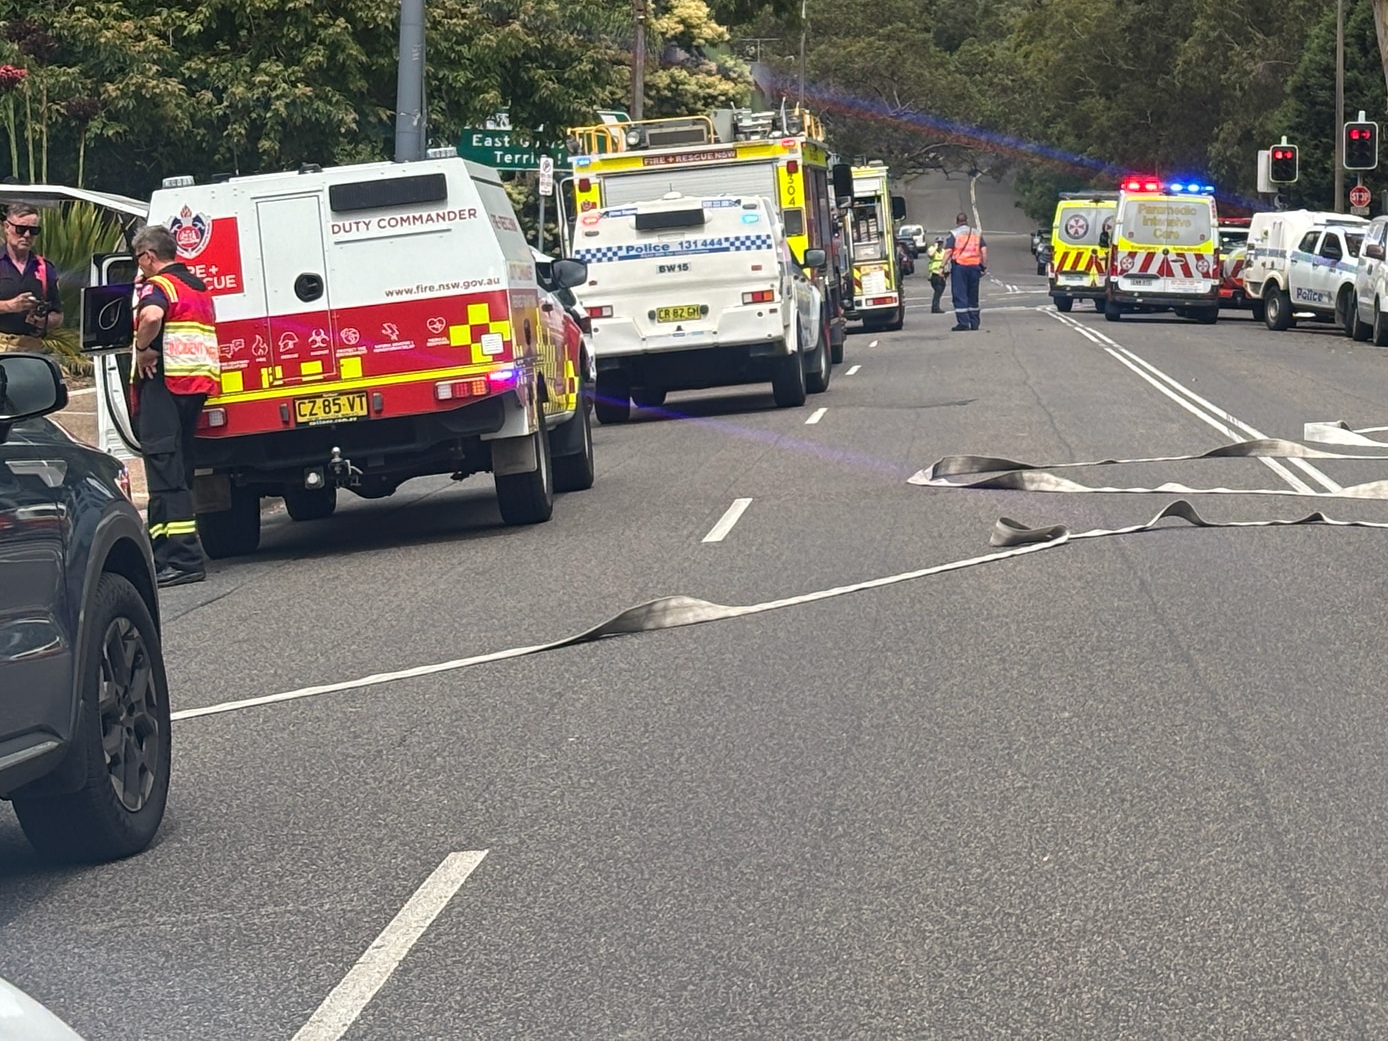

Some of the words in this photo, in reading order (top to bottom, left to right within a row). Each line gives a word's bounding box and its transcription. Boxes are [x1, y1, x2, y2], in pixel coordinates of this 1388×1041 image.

[472, 134, 510, 147] East
[643, 158, 666, 166] FIRE
[676, 152, 715, 163] RESCUE
[715, 150, 736, 160] NSW
[1351, 191, 1370, 201] STOP
[1138, 203, 1197, 216] Paramedic
[331, 219, 373, 235] DUTY
[377, 208, 478, 230] COMMANDER
[1153, 228, 1180, 240] Care
[625, 243, 670, 256] Police
[678, 240, 698, 251] 131
[701, 238, 723, 248] 444
[384, 276, 501, 299] www.fire.nsw.gov.au
[1296, 287, 1324, 302] Police
